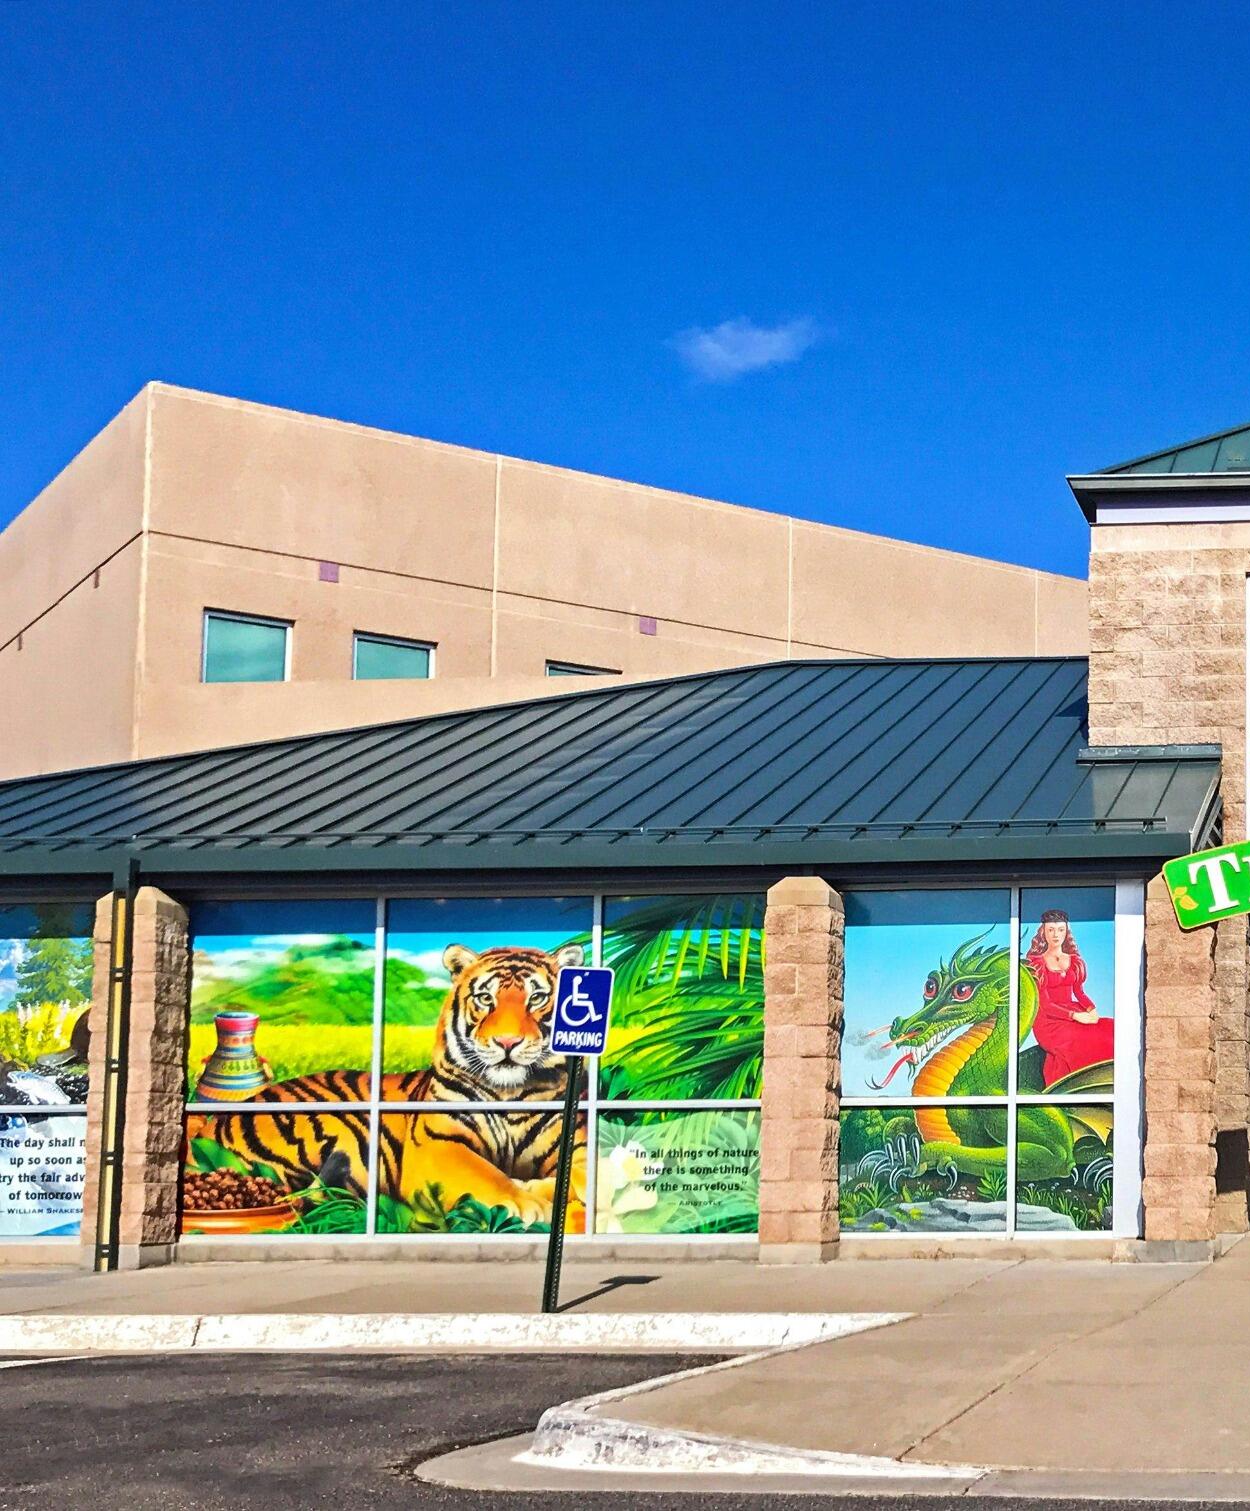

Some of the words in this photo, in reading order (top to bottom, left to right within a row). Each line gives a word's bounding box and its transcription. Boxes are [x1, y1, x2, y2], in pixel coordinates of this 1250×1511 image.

[554, 1030, 603, 1048] PARKING
[24, 1138, 44, 1150] day
[48, 1138, 75, 1148] shall
[650, 1149, 664, 1158] all
[668, 1148, 703, 1160] things
[707, 1148, 719, 1158] of
[722, 1149, 759, 1158] nature
[10, 1157, 24, 1168] up
[28, 1157, 41, 1165] so
[45, 1157, 72, 1165] soon
[643, 1165, 672, 1175] there
[676, 1165, 685, 1175] is
[689, 1165, 749, 1176] something
[18, 1173, 36, 1182] the
[41, 1172, 61, 1182] fair
[644, 1182, 656, 1191] of
[660, 1182, 678, 1191] the
[9, 1191, 21, 1200] of
[25, 1191, 83, 1200] tomorrow
